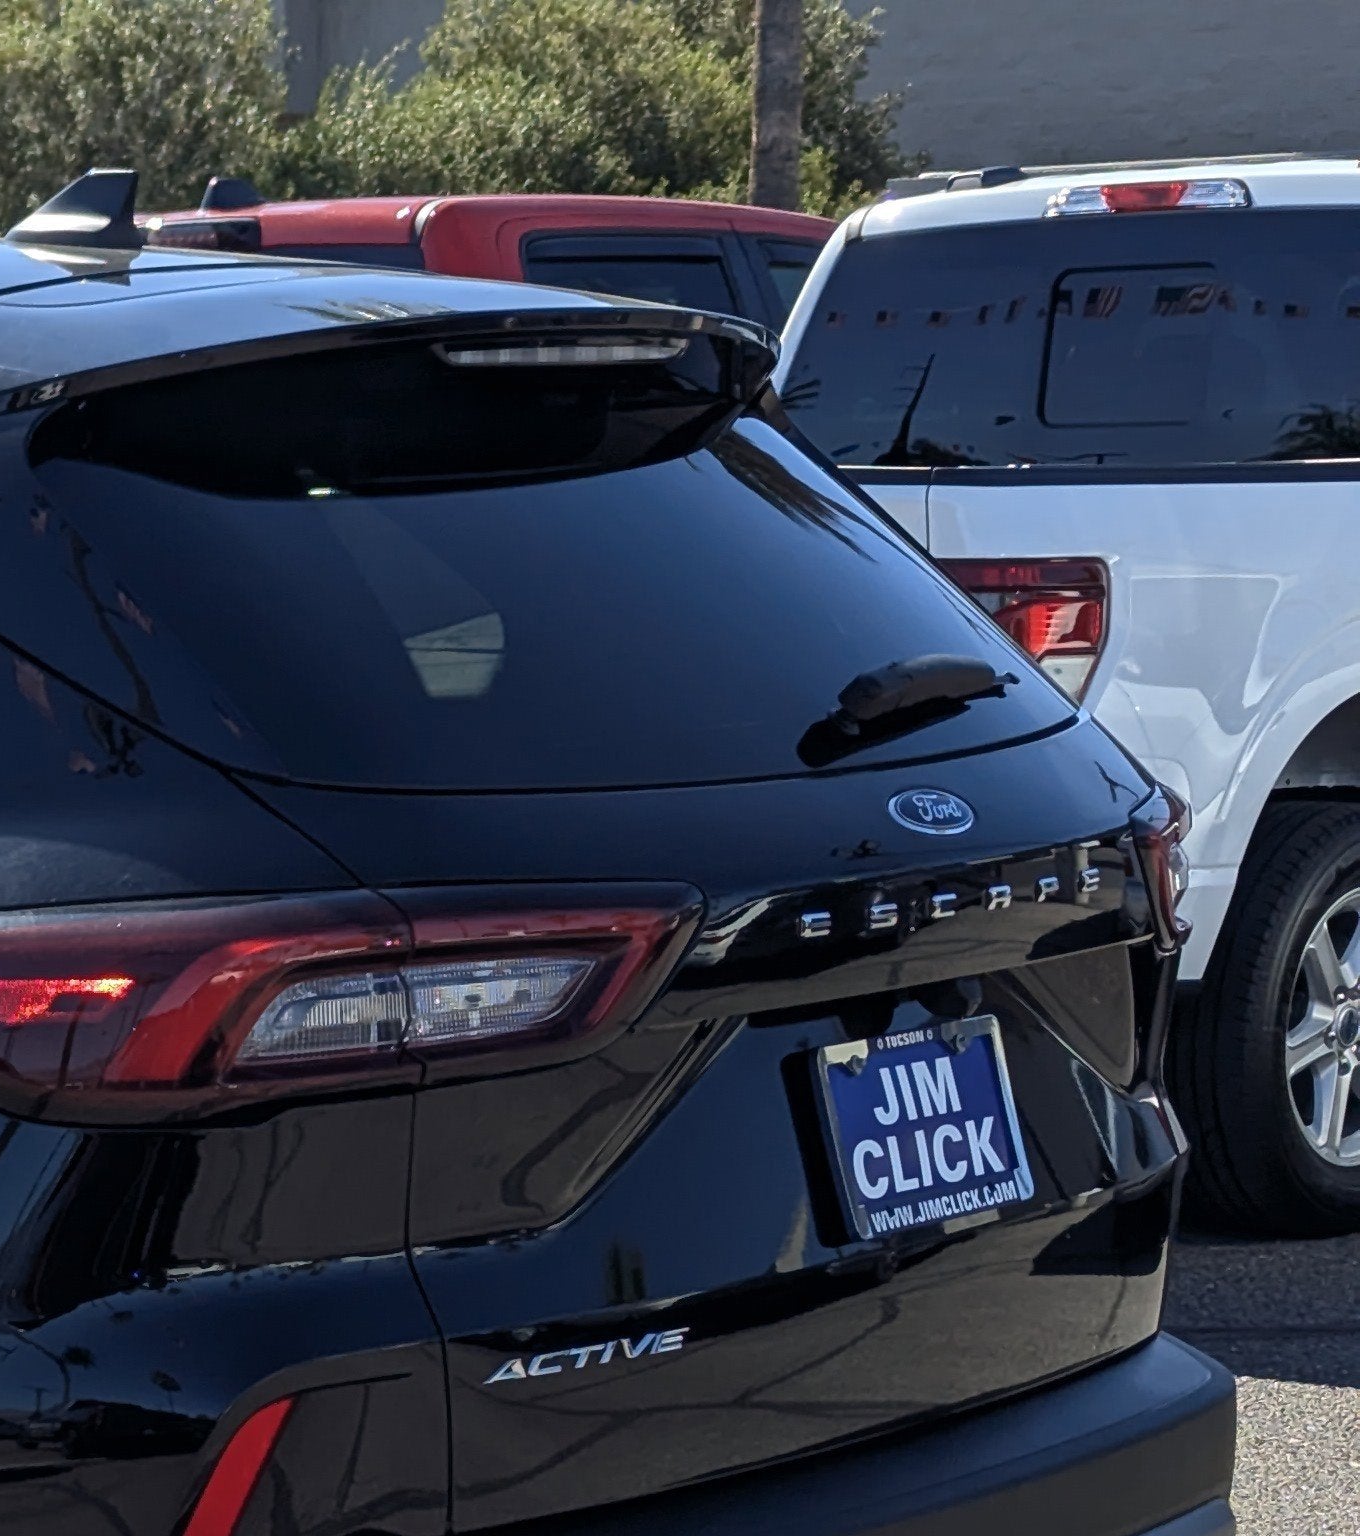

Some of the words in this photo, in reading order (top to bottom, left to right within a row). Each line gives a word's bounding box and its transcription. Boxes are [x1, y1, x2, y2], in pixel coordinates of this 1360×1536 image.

[912, 795, 962, 821] Ford
[799, 867, 1101, 938] ESCAPE
[885, 1030, 925, 1049] TUCSON
[873, 1056, 962, 1126] JIM
[852, 1116, 1007, 1200] CLICK
[870, 1180, 1018, 1233] WWW.JIMCLICK.COM
[482, 1327, 691, 1384] ACTIVE
